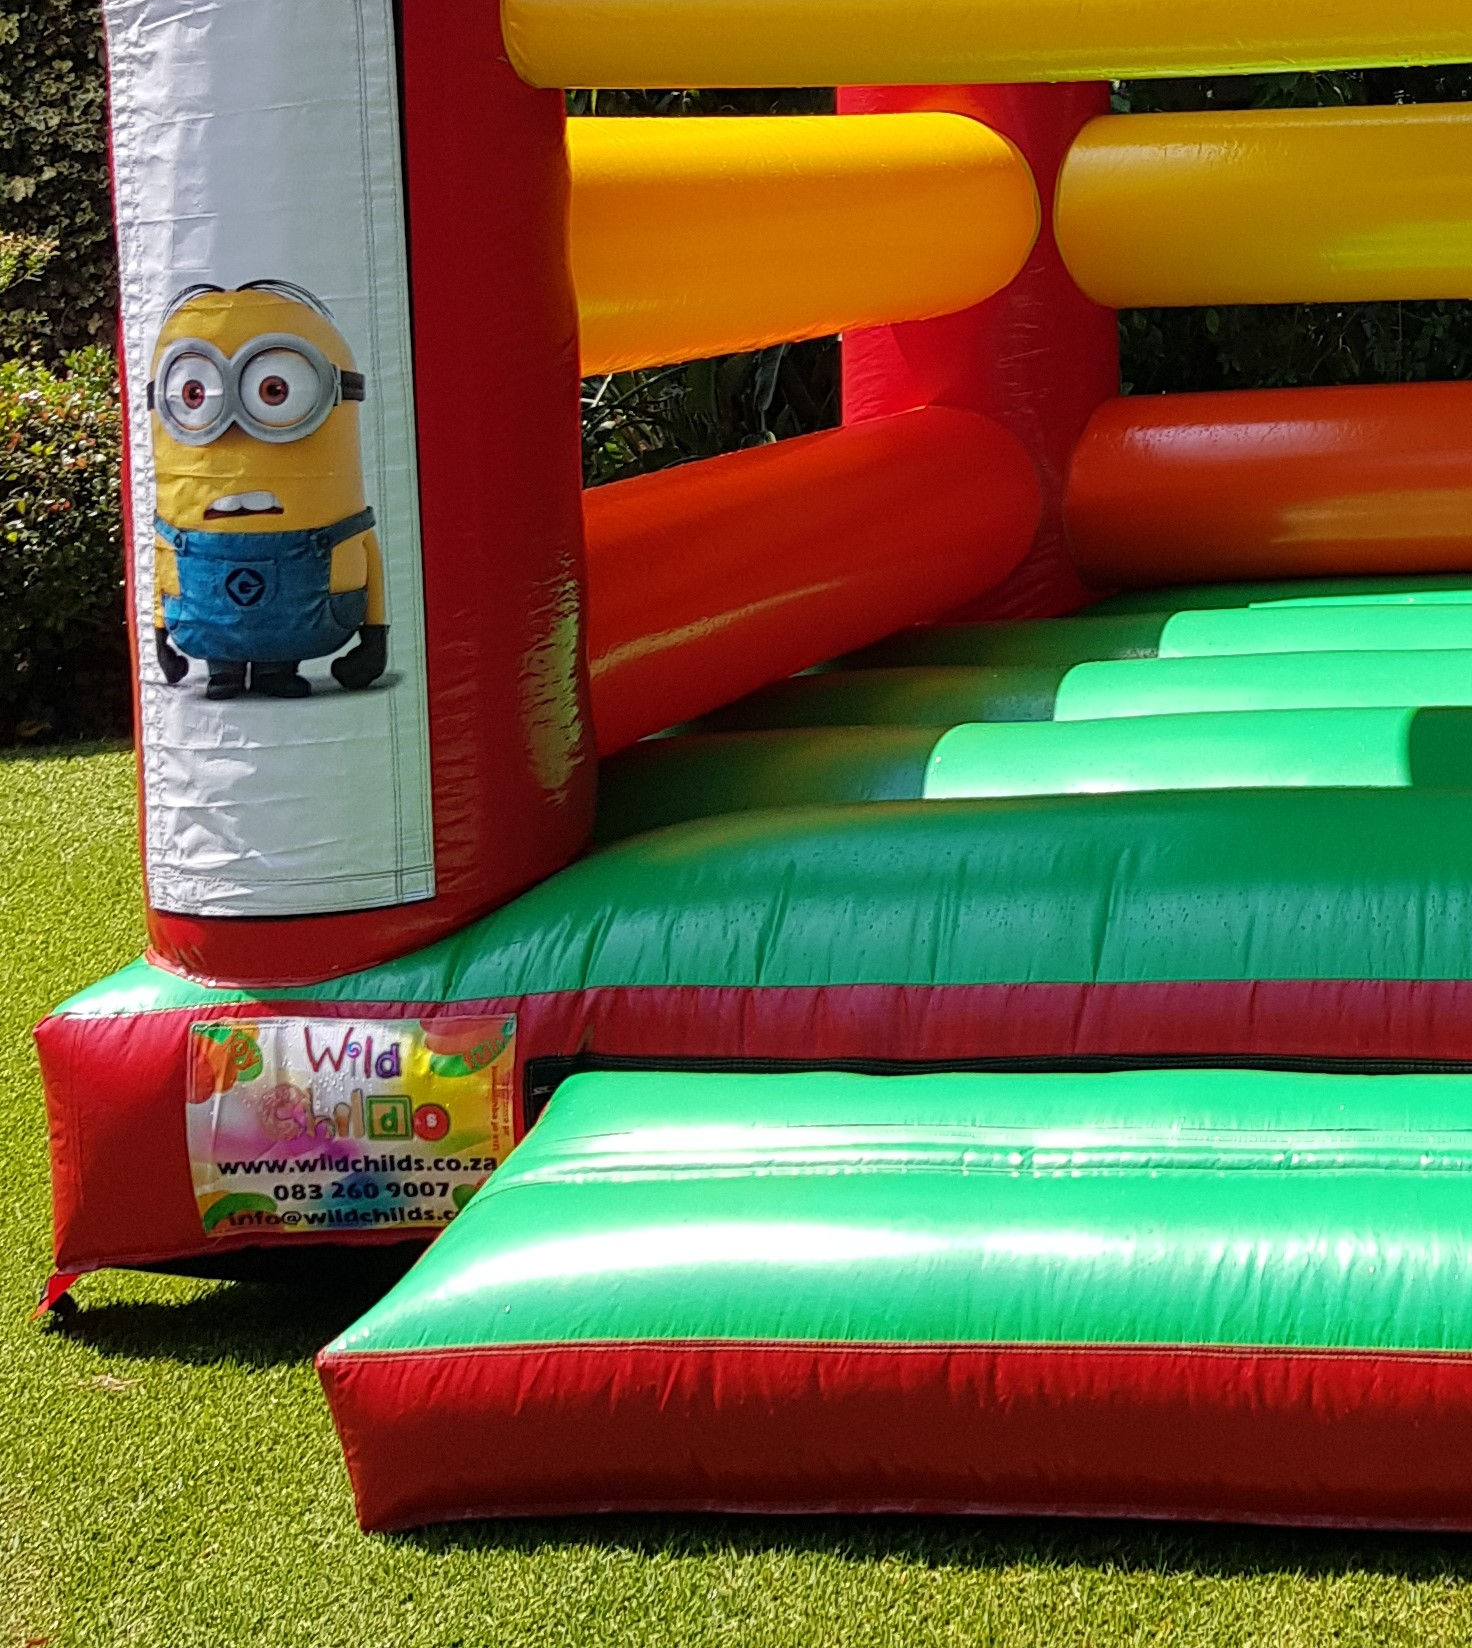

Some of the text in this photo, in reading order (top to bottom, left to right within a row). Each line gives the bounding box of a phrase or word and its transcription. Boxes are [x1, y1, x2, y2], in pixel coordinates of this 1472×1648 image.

[304, 1026, 402, 1079] Wild
[217, 1154, 498, 1175] www.wildchilds.co.za
[273, 1181, 451, 1202] 083 260 9007
